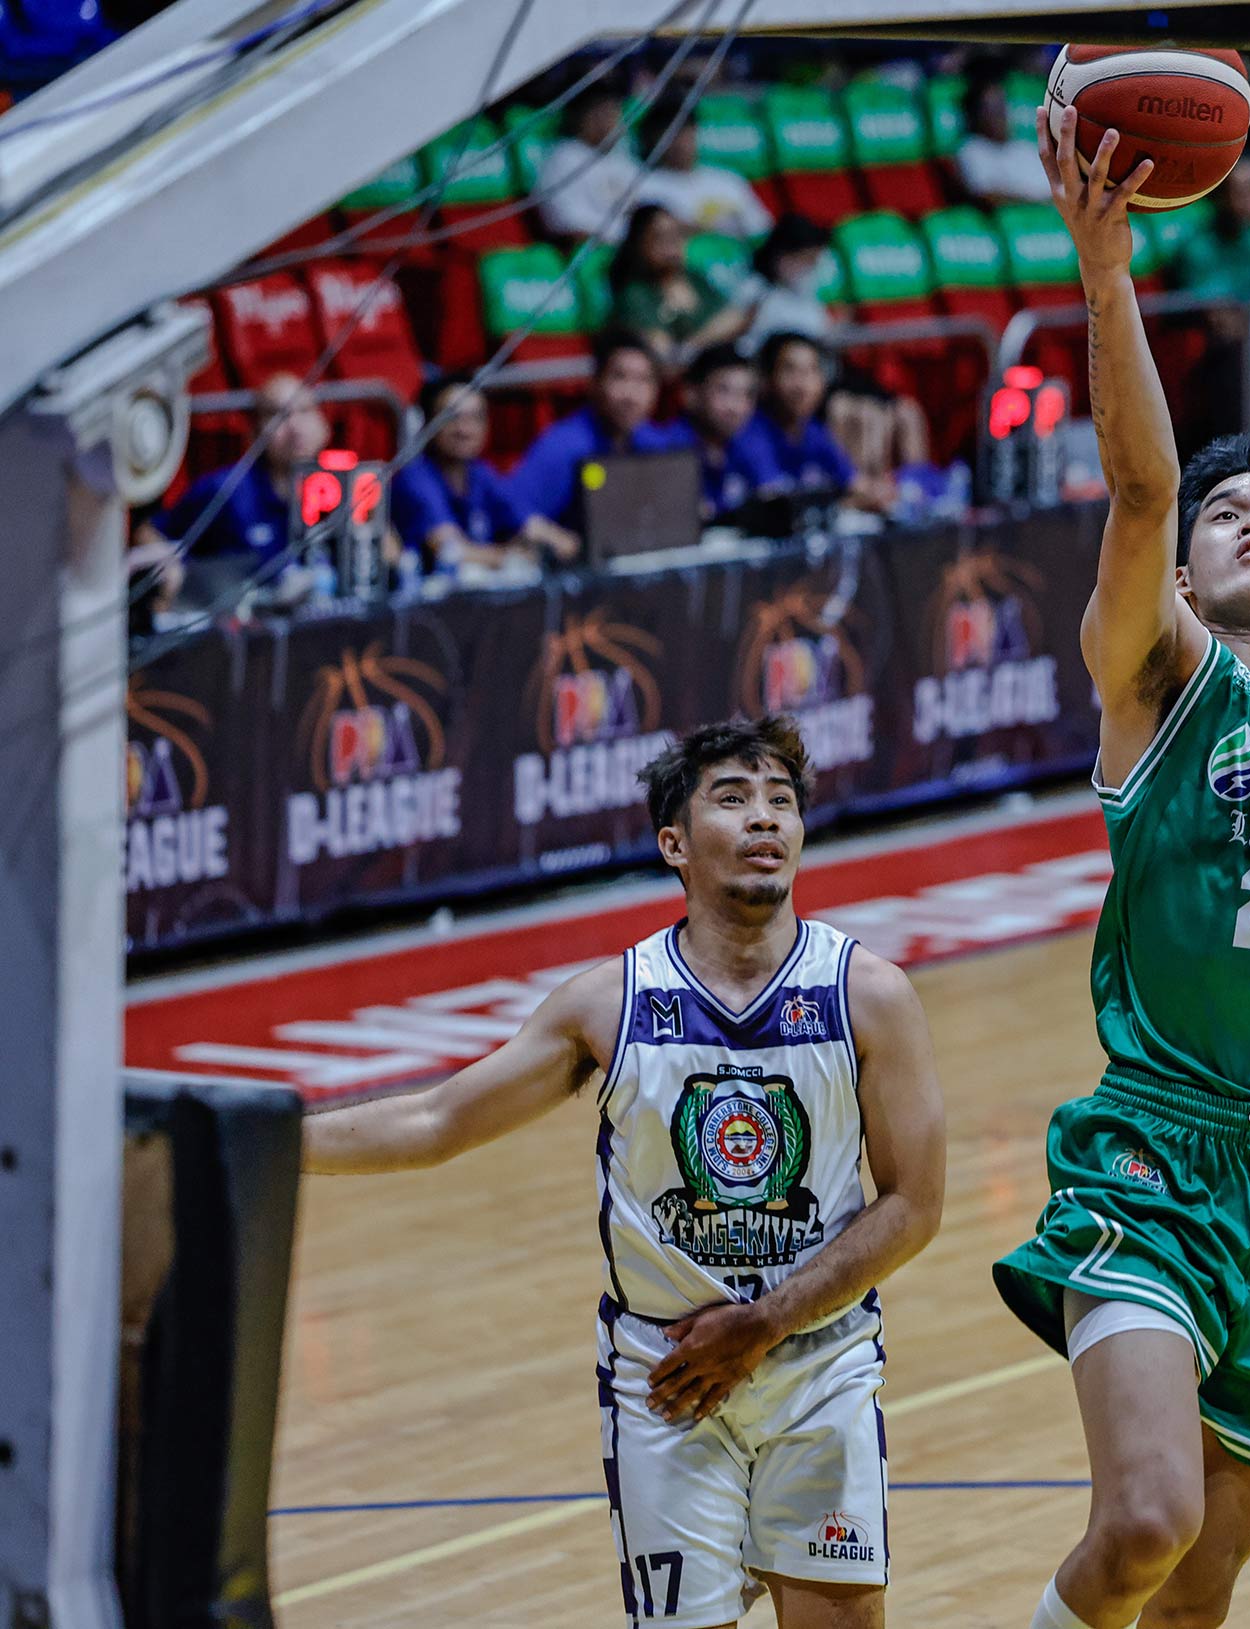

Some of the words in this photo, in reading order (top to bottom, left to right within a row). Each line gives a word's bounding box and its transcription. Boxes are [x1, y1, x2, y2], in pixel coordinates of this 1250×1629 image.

[1137, 95, 1224, 124] molten
[125, 804, 230, 893] AGUE
[718, 1066, 761, 1078] SJDMCCI
[706, 1100, 753, 1144] CORNERSTONE
[755, 1111, 775, 1151] COLLEGE
[825, 1526, 859, 1543] PBA
[808, 1541, 874, 1562] D-LEAGUE
[635, 1551, 684, 1618] 17
